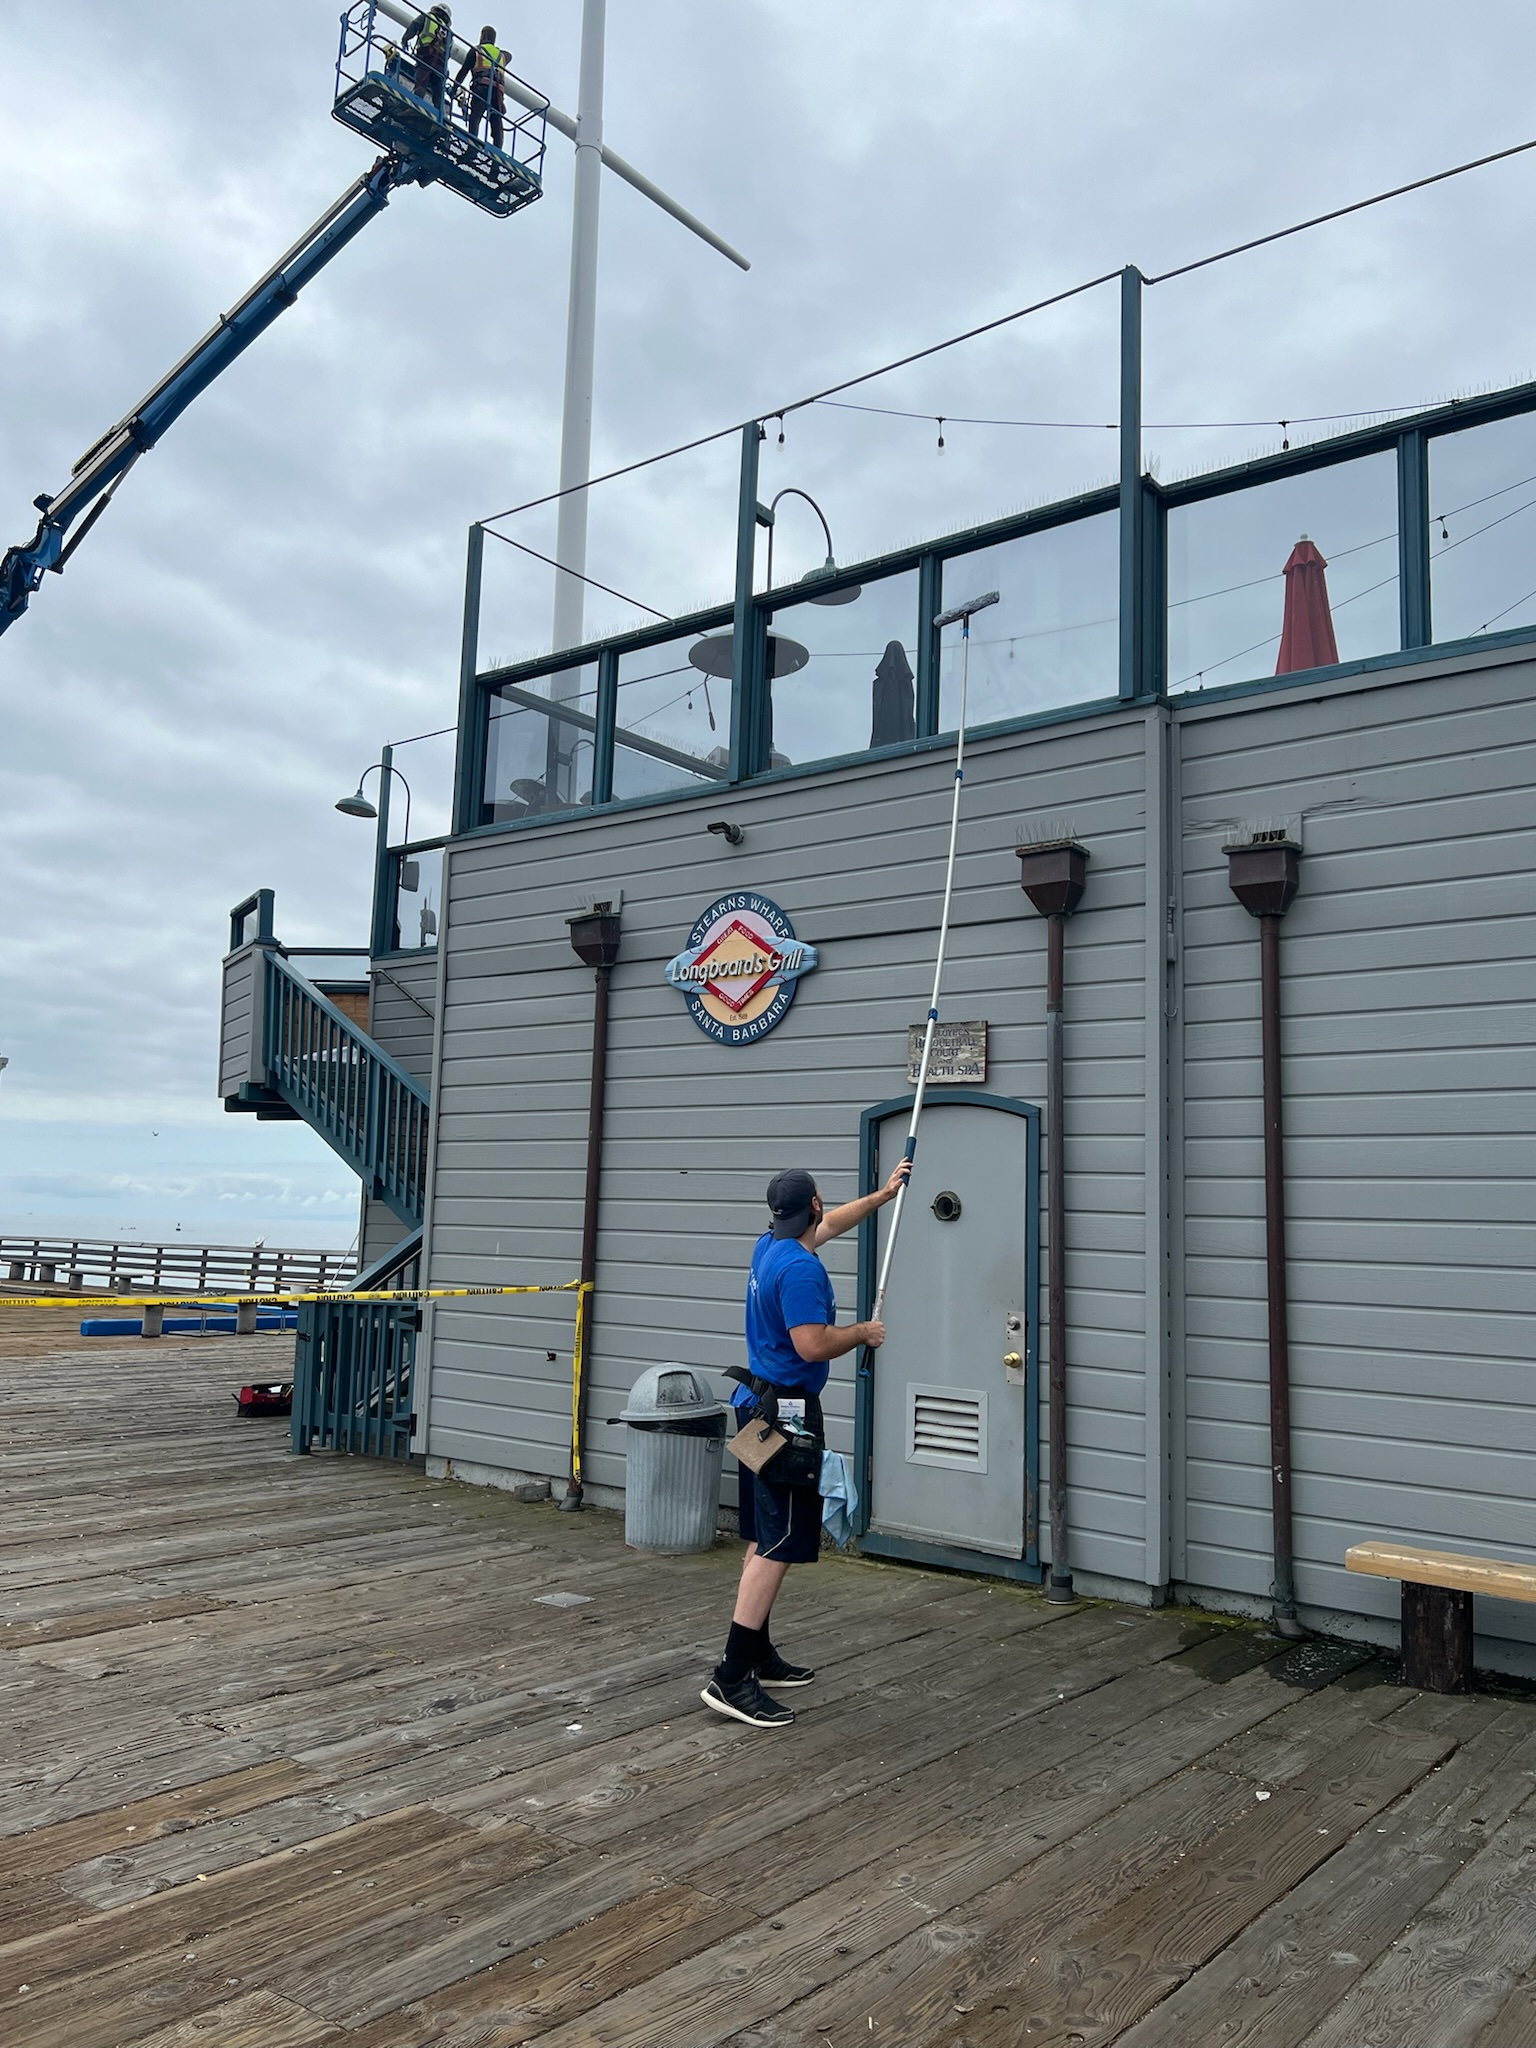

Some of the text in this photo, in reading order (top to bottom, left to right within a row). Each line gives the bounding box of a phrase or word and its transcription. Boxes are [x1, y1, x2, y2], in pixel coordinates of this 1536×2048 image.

[692, 896, 789, 944] STEARNS WHARF
[716, 925, 754, 945] GREAT FOOD
[767, 948, 803, 972] Grill
[718, 989, 755, 1008] GOOD TIMES
[691, 993, 789, 1041] SANTA BARBARA
[930, 1047, 960, 1057] COURT
[912, 1063, 954, 1077] HALTH
[316, 1293, 355, 1301] CAUTION
[392, 1290, 430, 1299] CAUTION
[466, 1287, 503, 1296] CAUTION
